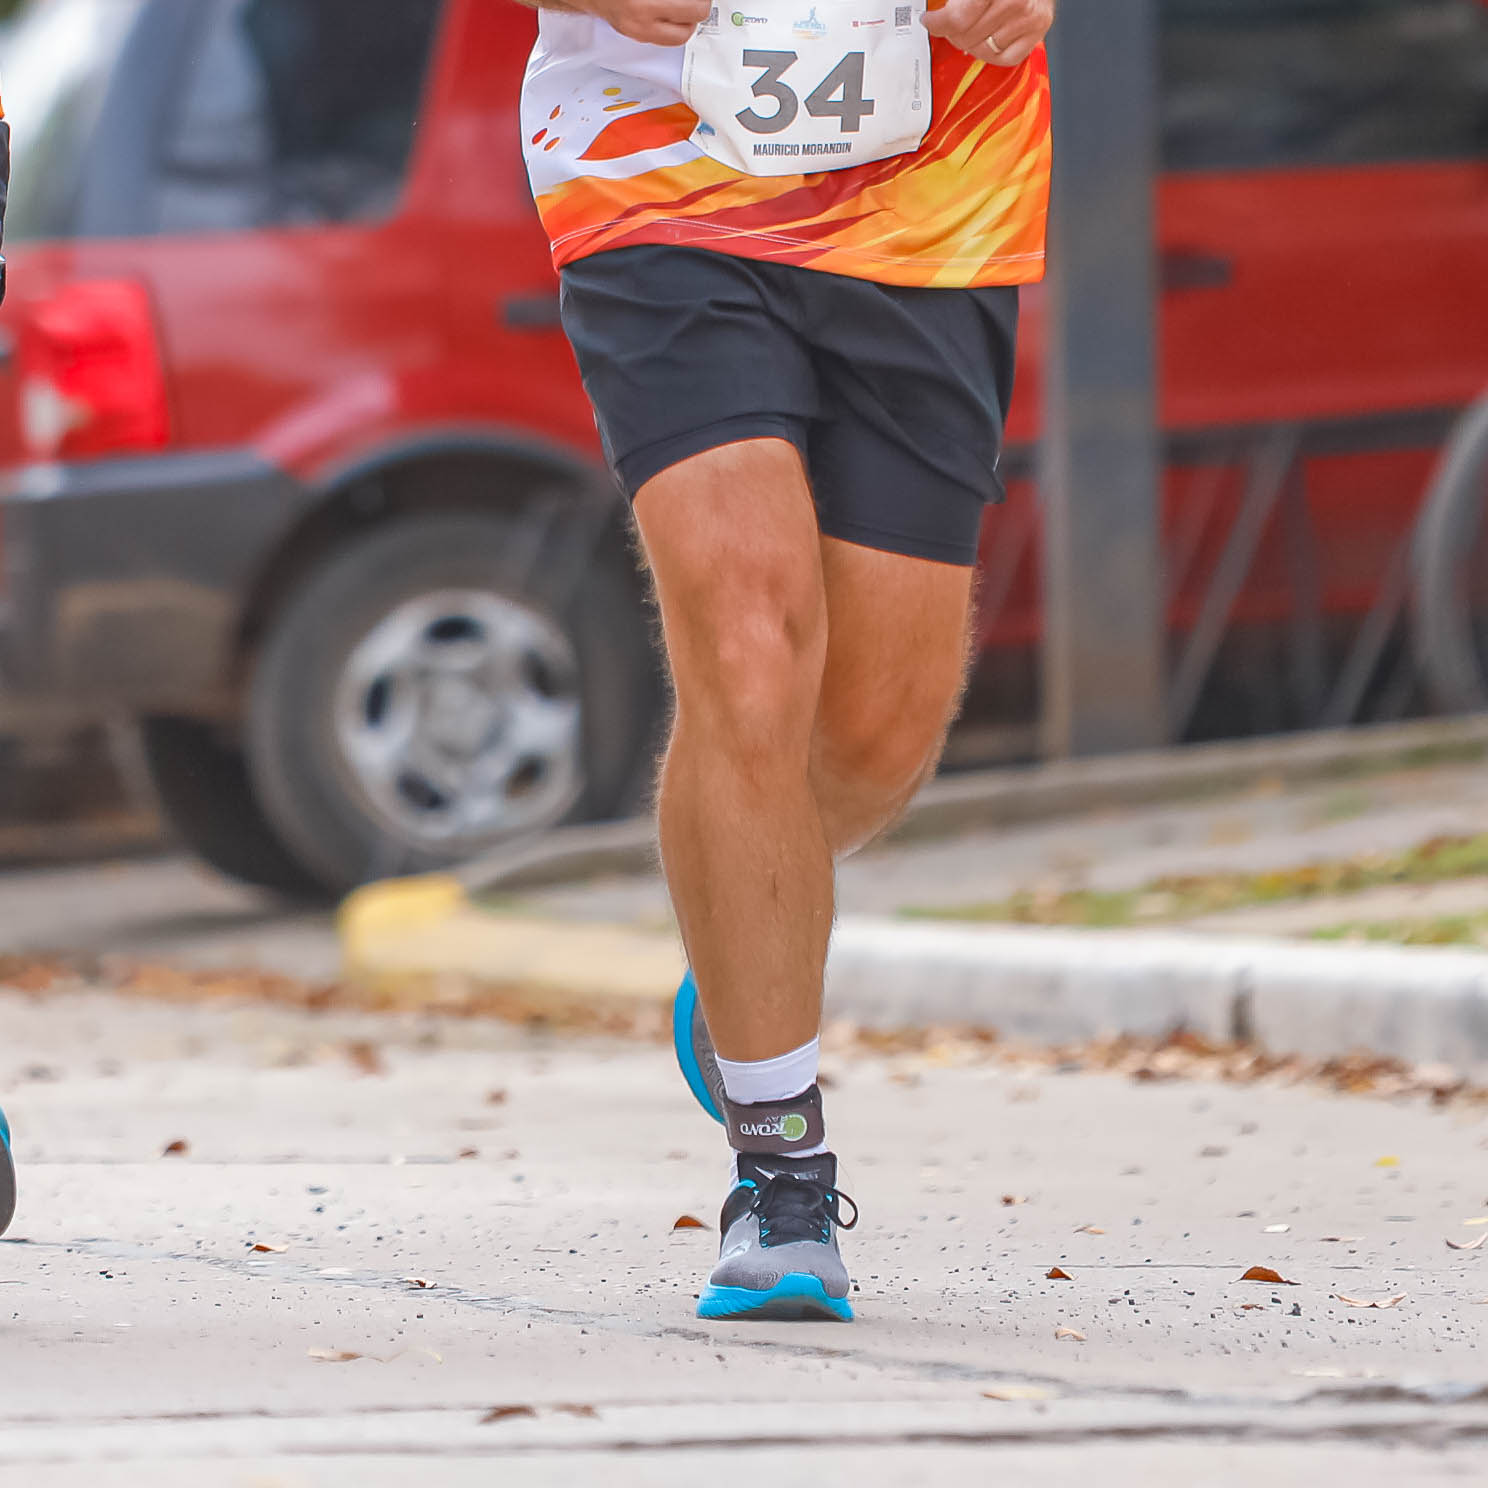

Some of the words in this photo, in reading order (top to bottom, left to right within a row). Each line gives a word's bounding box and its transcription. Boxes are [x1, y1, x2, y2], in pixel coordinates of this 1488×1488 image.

[735, 49, 875, 135] 34
[753, 143, 800, 157] MAURICIO
[801, 142, 853, 157] MORANDIN
